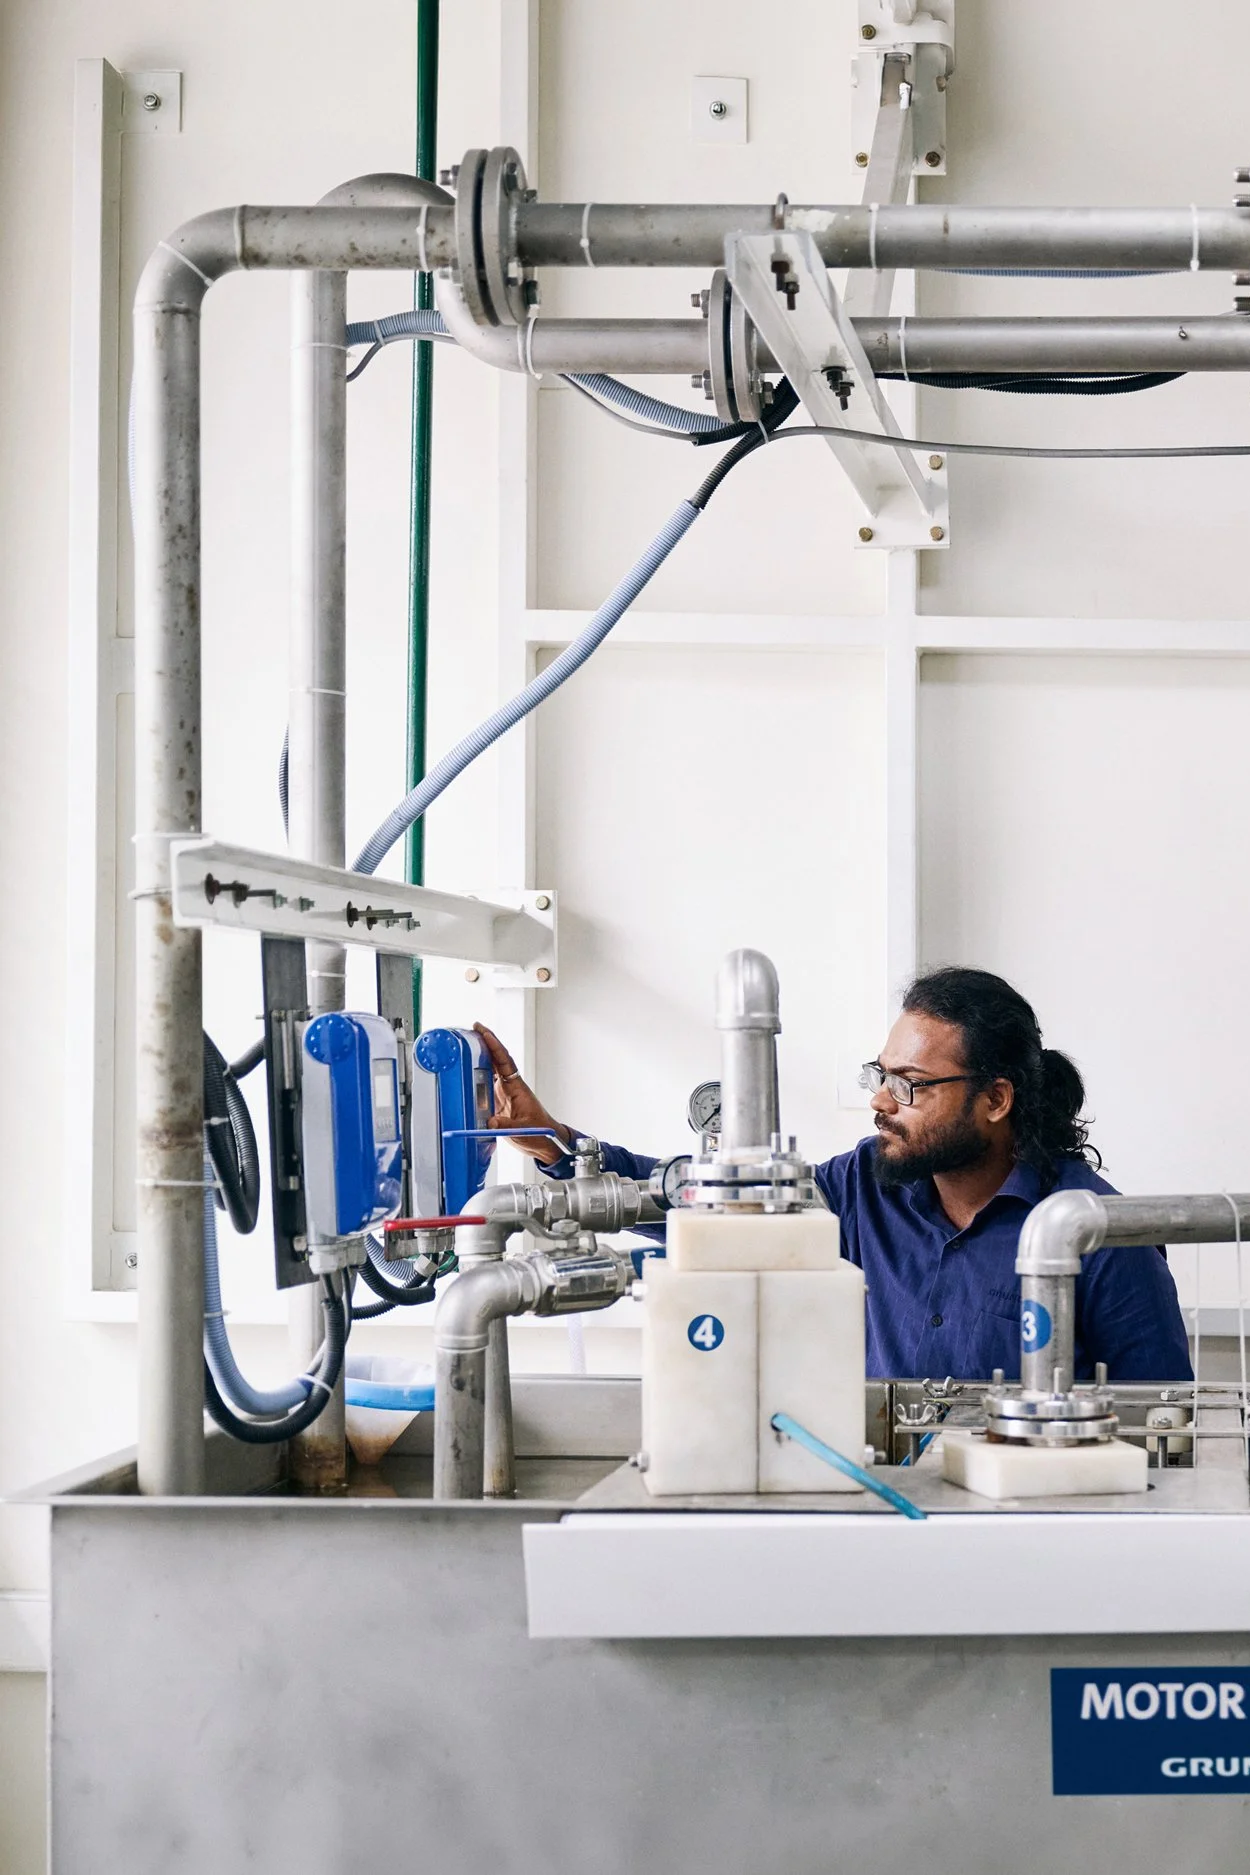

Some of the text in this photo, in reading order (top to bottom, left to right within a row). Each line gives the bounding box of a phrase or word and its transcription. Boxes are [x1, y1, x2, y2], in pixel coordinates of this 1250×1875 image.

[693, 1316, 717, 1348] 4
[1021, 1310, 1037, 1342] 3
[1081, 1682, 1246, 1720] MOTOR
